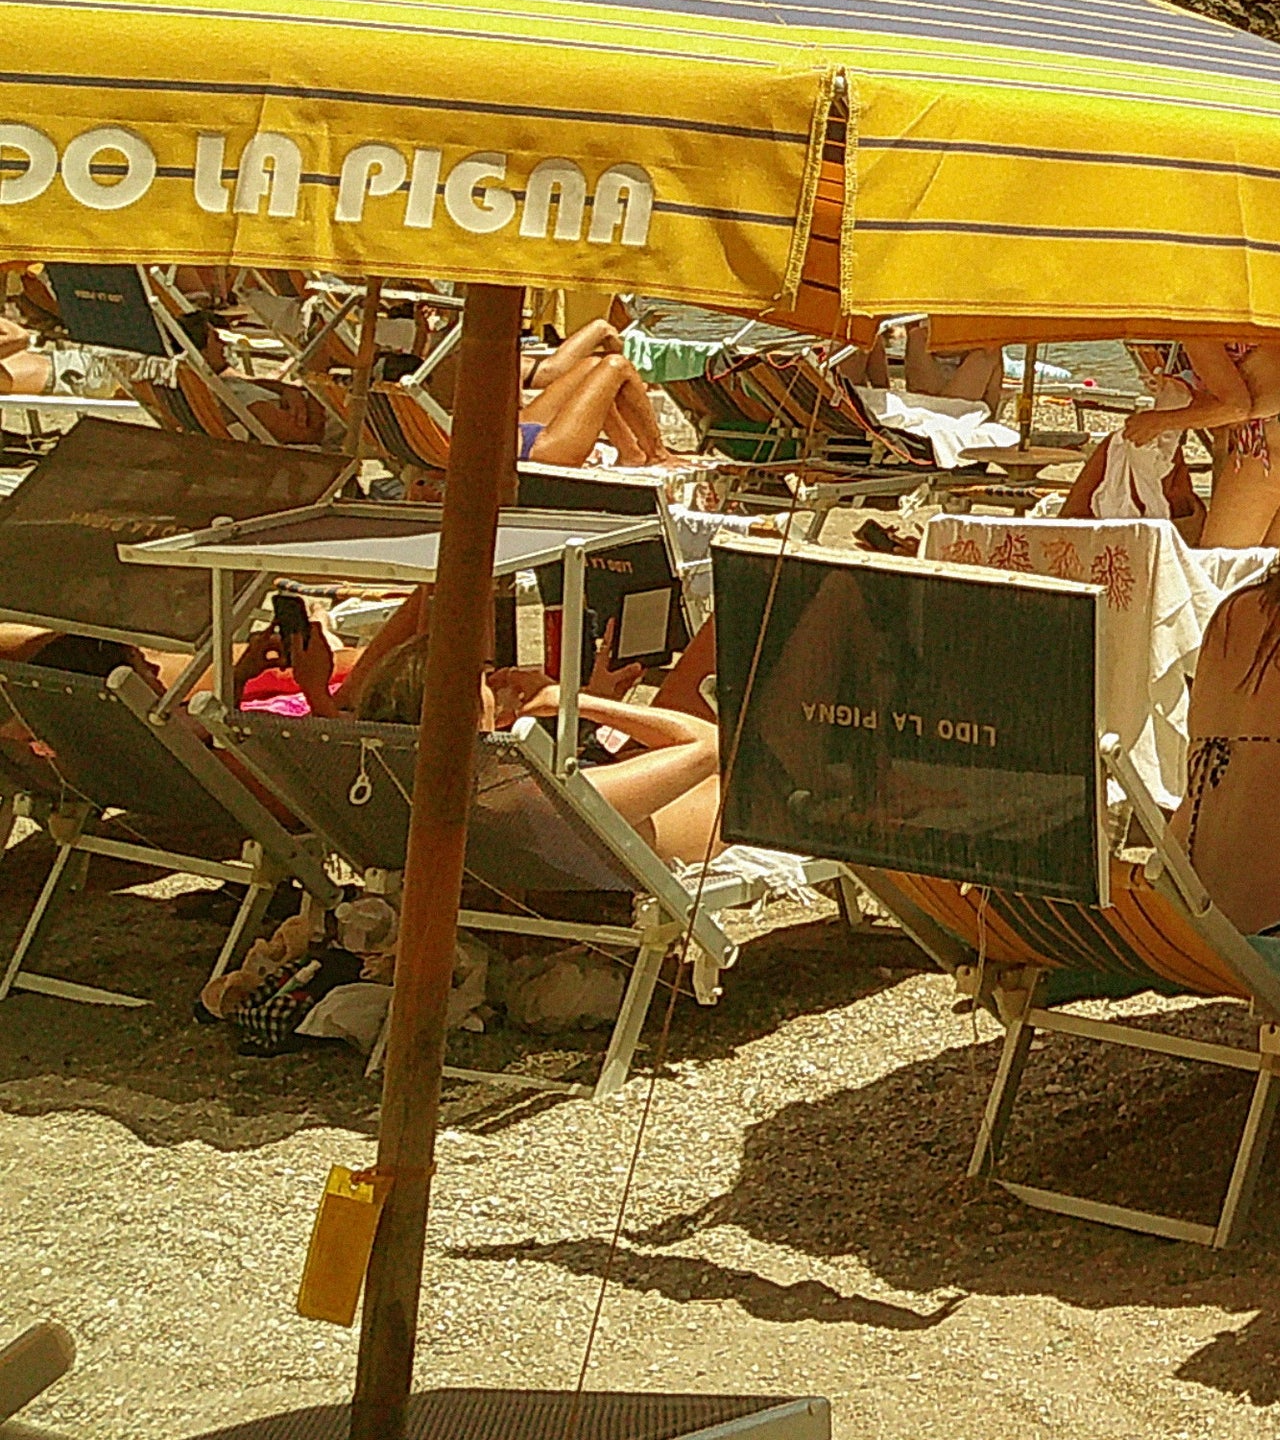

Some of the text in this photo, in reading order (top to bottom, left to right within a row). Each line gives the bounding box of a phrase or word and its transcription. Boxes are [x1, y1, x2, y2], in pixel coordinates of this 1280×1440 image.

[193, 130, 302, 218] LA
[334, 143, 655, 247] PIGNA
[801, 702, 997, 747] LIDO LA PIGNA
